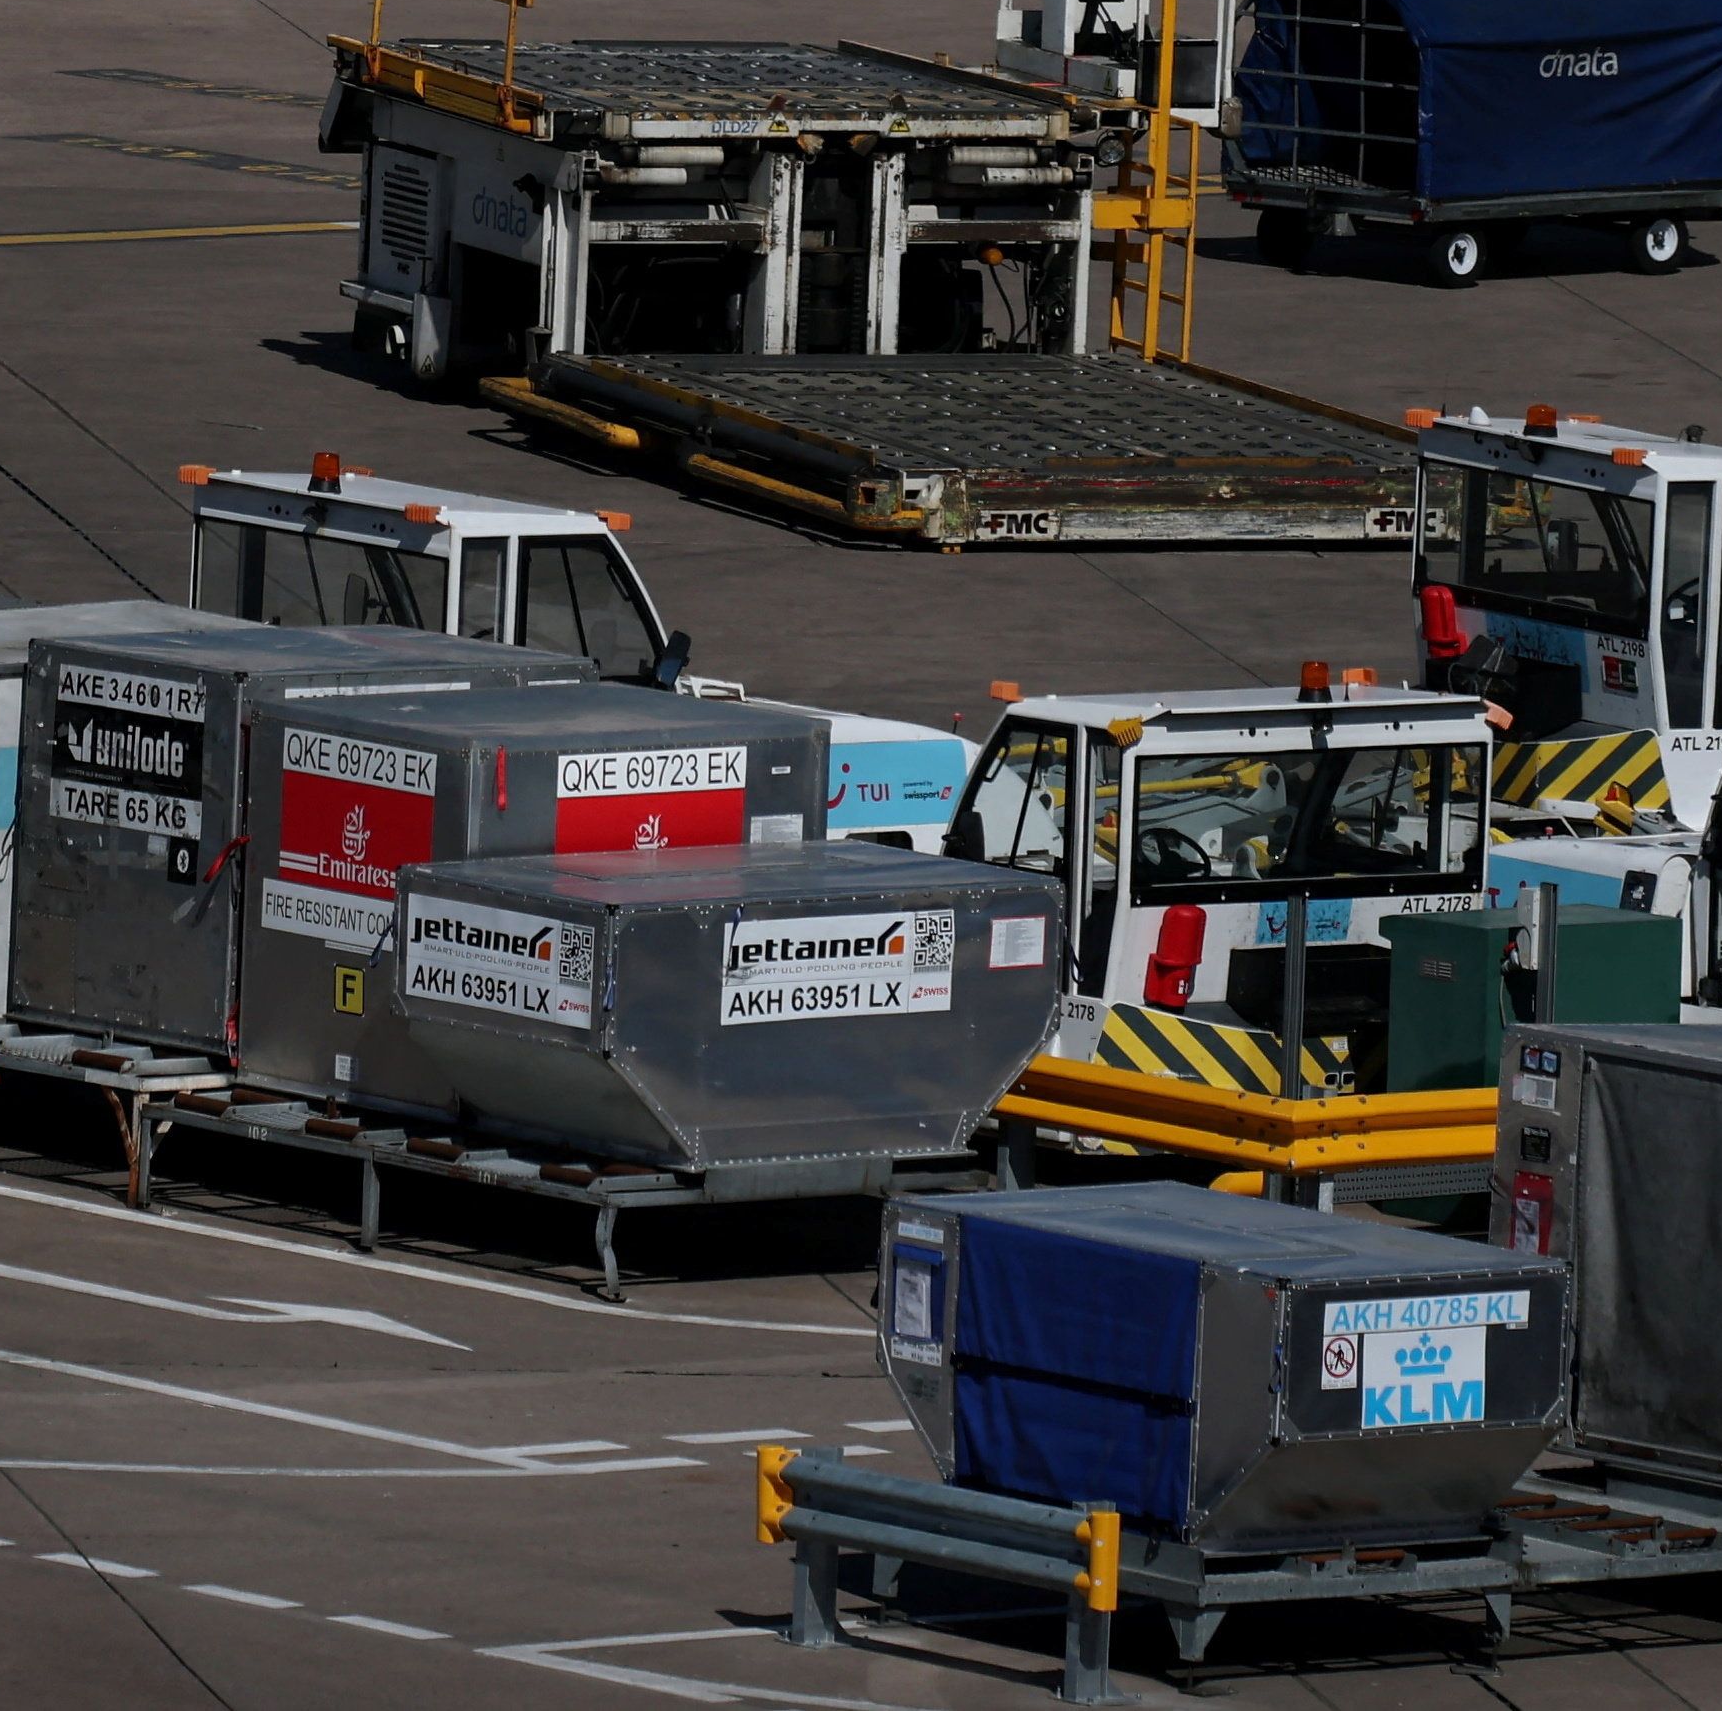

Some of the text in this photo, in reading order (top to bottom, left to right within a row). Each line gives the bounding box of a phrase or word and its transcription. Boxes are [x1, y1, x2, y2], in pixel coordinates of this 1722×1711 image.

[1539, 46, 1619, 79] dnata
[711, 120, 758, 135] DLD27
[471, 186, 527, 239] dnata
[985, 511, 1051, 536] FMC
[1597, 635, 1646, 658] ATL 2198
[96, 724, 184, 779] unilode
[287, 732, 433, 791] QKE 69723 EK
[1672, 736, 1702, 751] ATL
[562, 751, 741, 793] QKE 69723 EK
[64, 787, 186, 830] TARE 65 KG
[856, 783, 890, 802] TUI
[903, 790, 940, 801] swissport
[319, 852, 390, 889] Emirates
[265, 892, 292, 919] FIRE
[296, 898, 365, 933] RESISTANT
[1401, 895, 1472, 914] ATL 2178
[410, 917, 555, 961] jettainer
[342, 972, 357, 1007] F
[412, 964, 550, 1015] AKH 63951 LX
[568, 1000, 590, 1014] SWISS
[728, 981, 902, 1019] AKH 63951 LX
[923, 987, 949, 997] SWISS
[1067, 1002, 1096, 1021] 2178
[1331, 1294, 1522, 1332] AKH 40785 KL
[1363, 1379, 1484, 1427] KLM
